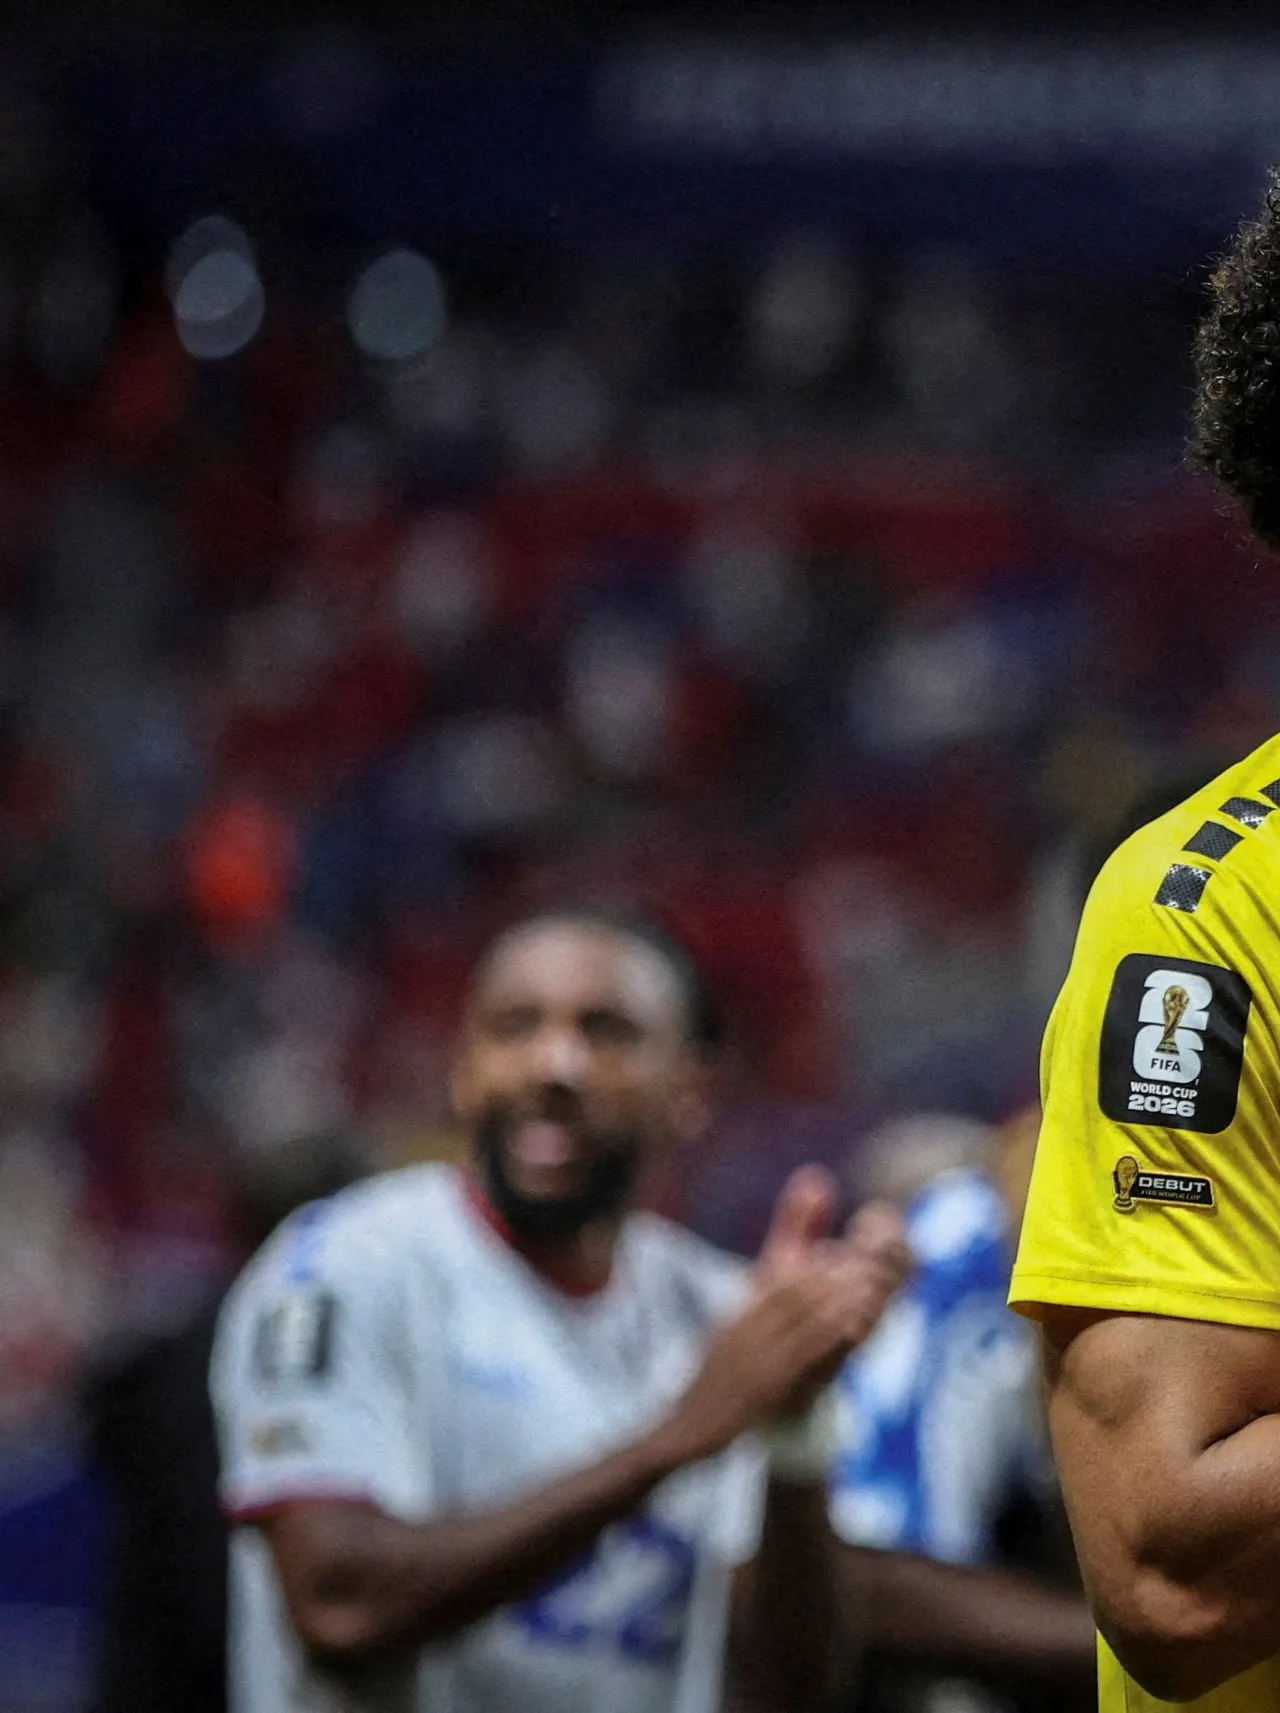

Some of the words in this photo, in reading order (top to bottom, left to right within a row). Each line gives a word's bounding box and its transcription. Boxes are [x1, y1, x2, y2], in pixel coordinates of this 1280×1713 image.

[1151, 1058, 1181, 1073] FIFA
[1130, 1081, 1172, 1096] WORLD
[1172, 1087, 1198, 1100] CUP
[1128, 1094, 1195, 1117] 2026
[1138, 1176, 1206, 1193] DEBUT
